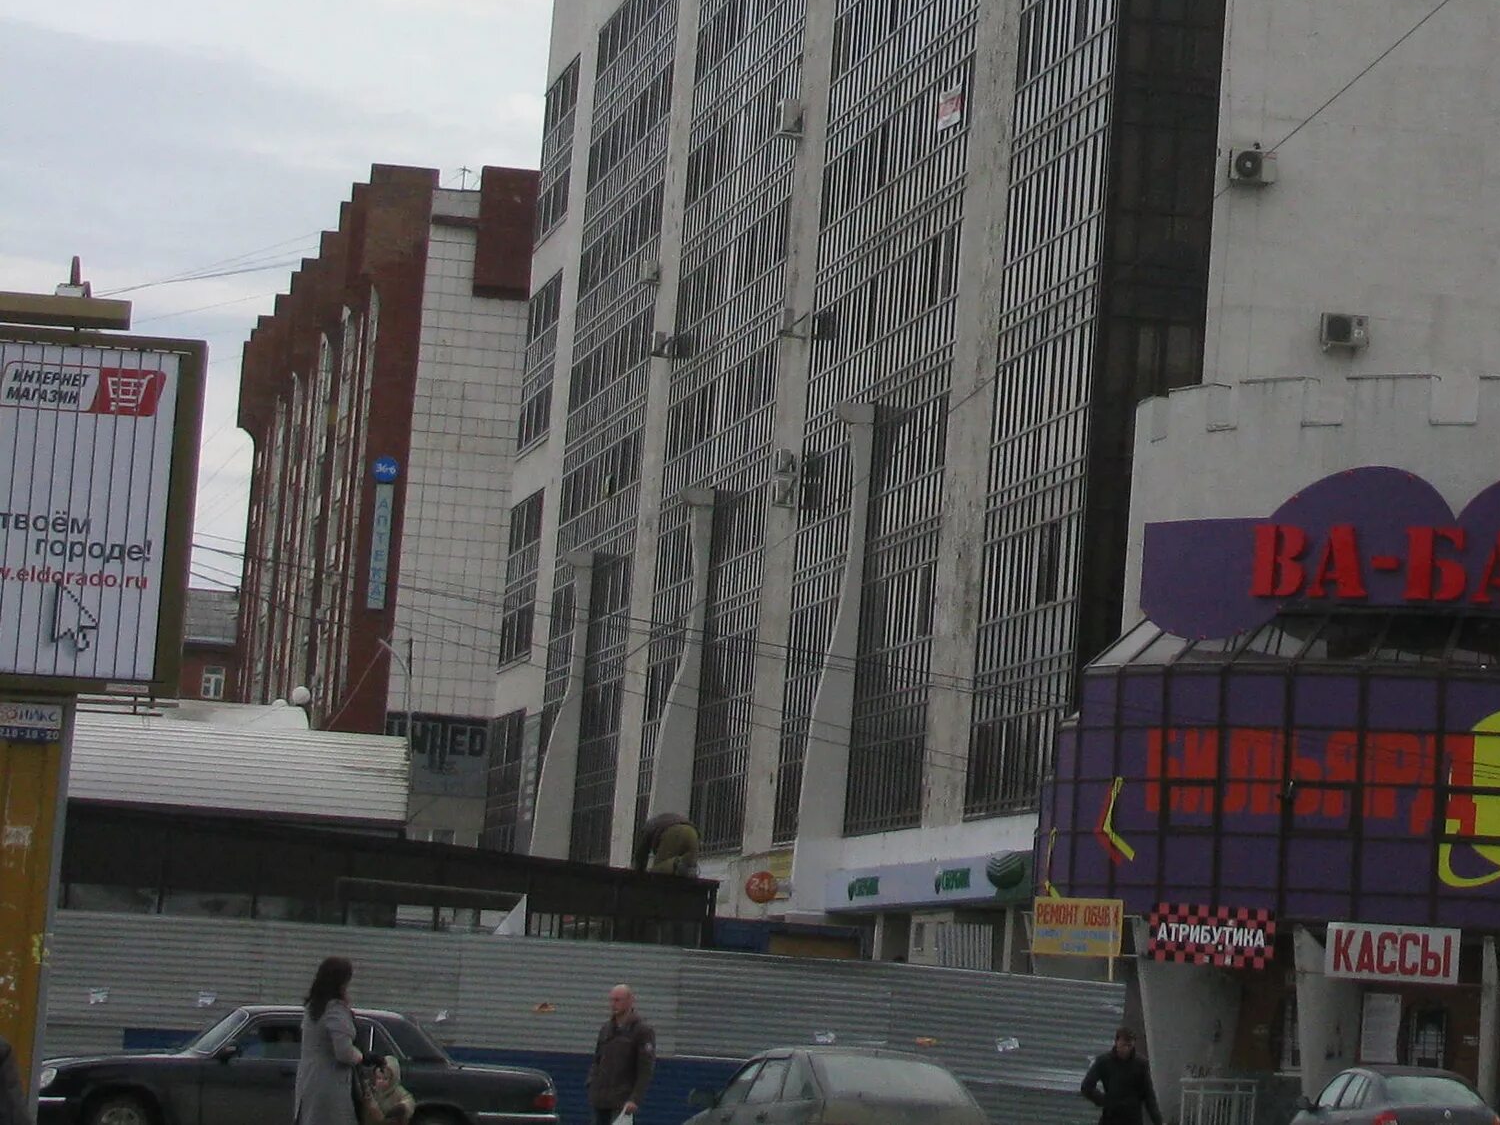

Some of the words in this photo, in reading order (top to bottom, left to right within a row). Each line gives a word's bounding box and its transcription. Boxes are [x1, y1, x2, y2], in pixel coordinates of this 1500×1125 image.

[12, 368, 90, 388] ИНТЕРНЕТ
[6, 386, 80, 405] МАГАЗИН
[35, 538, 152, 565] городе!
[369, 497, 389, 600] АПТЕКА
[1145, 726, 1477, 837] БИЛЬЯРД
[750, 877, 769, 892] 24
[1036, 903, 1079, 926] РЕМОНТ
[1156, 921, 1266, 948] АТРИБУТИКА
[1333, 928, 1453, 978] КАССЫ
